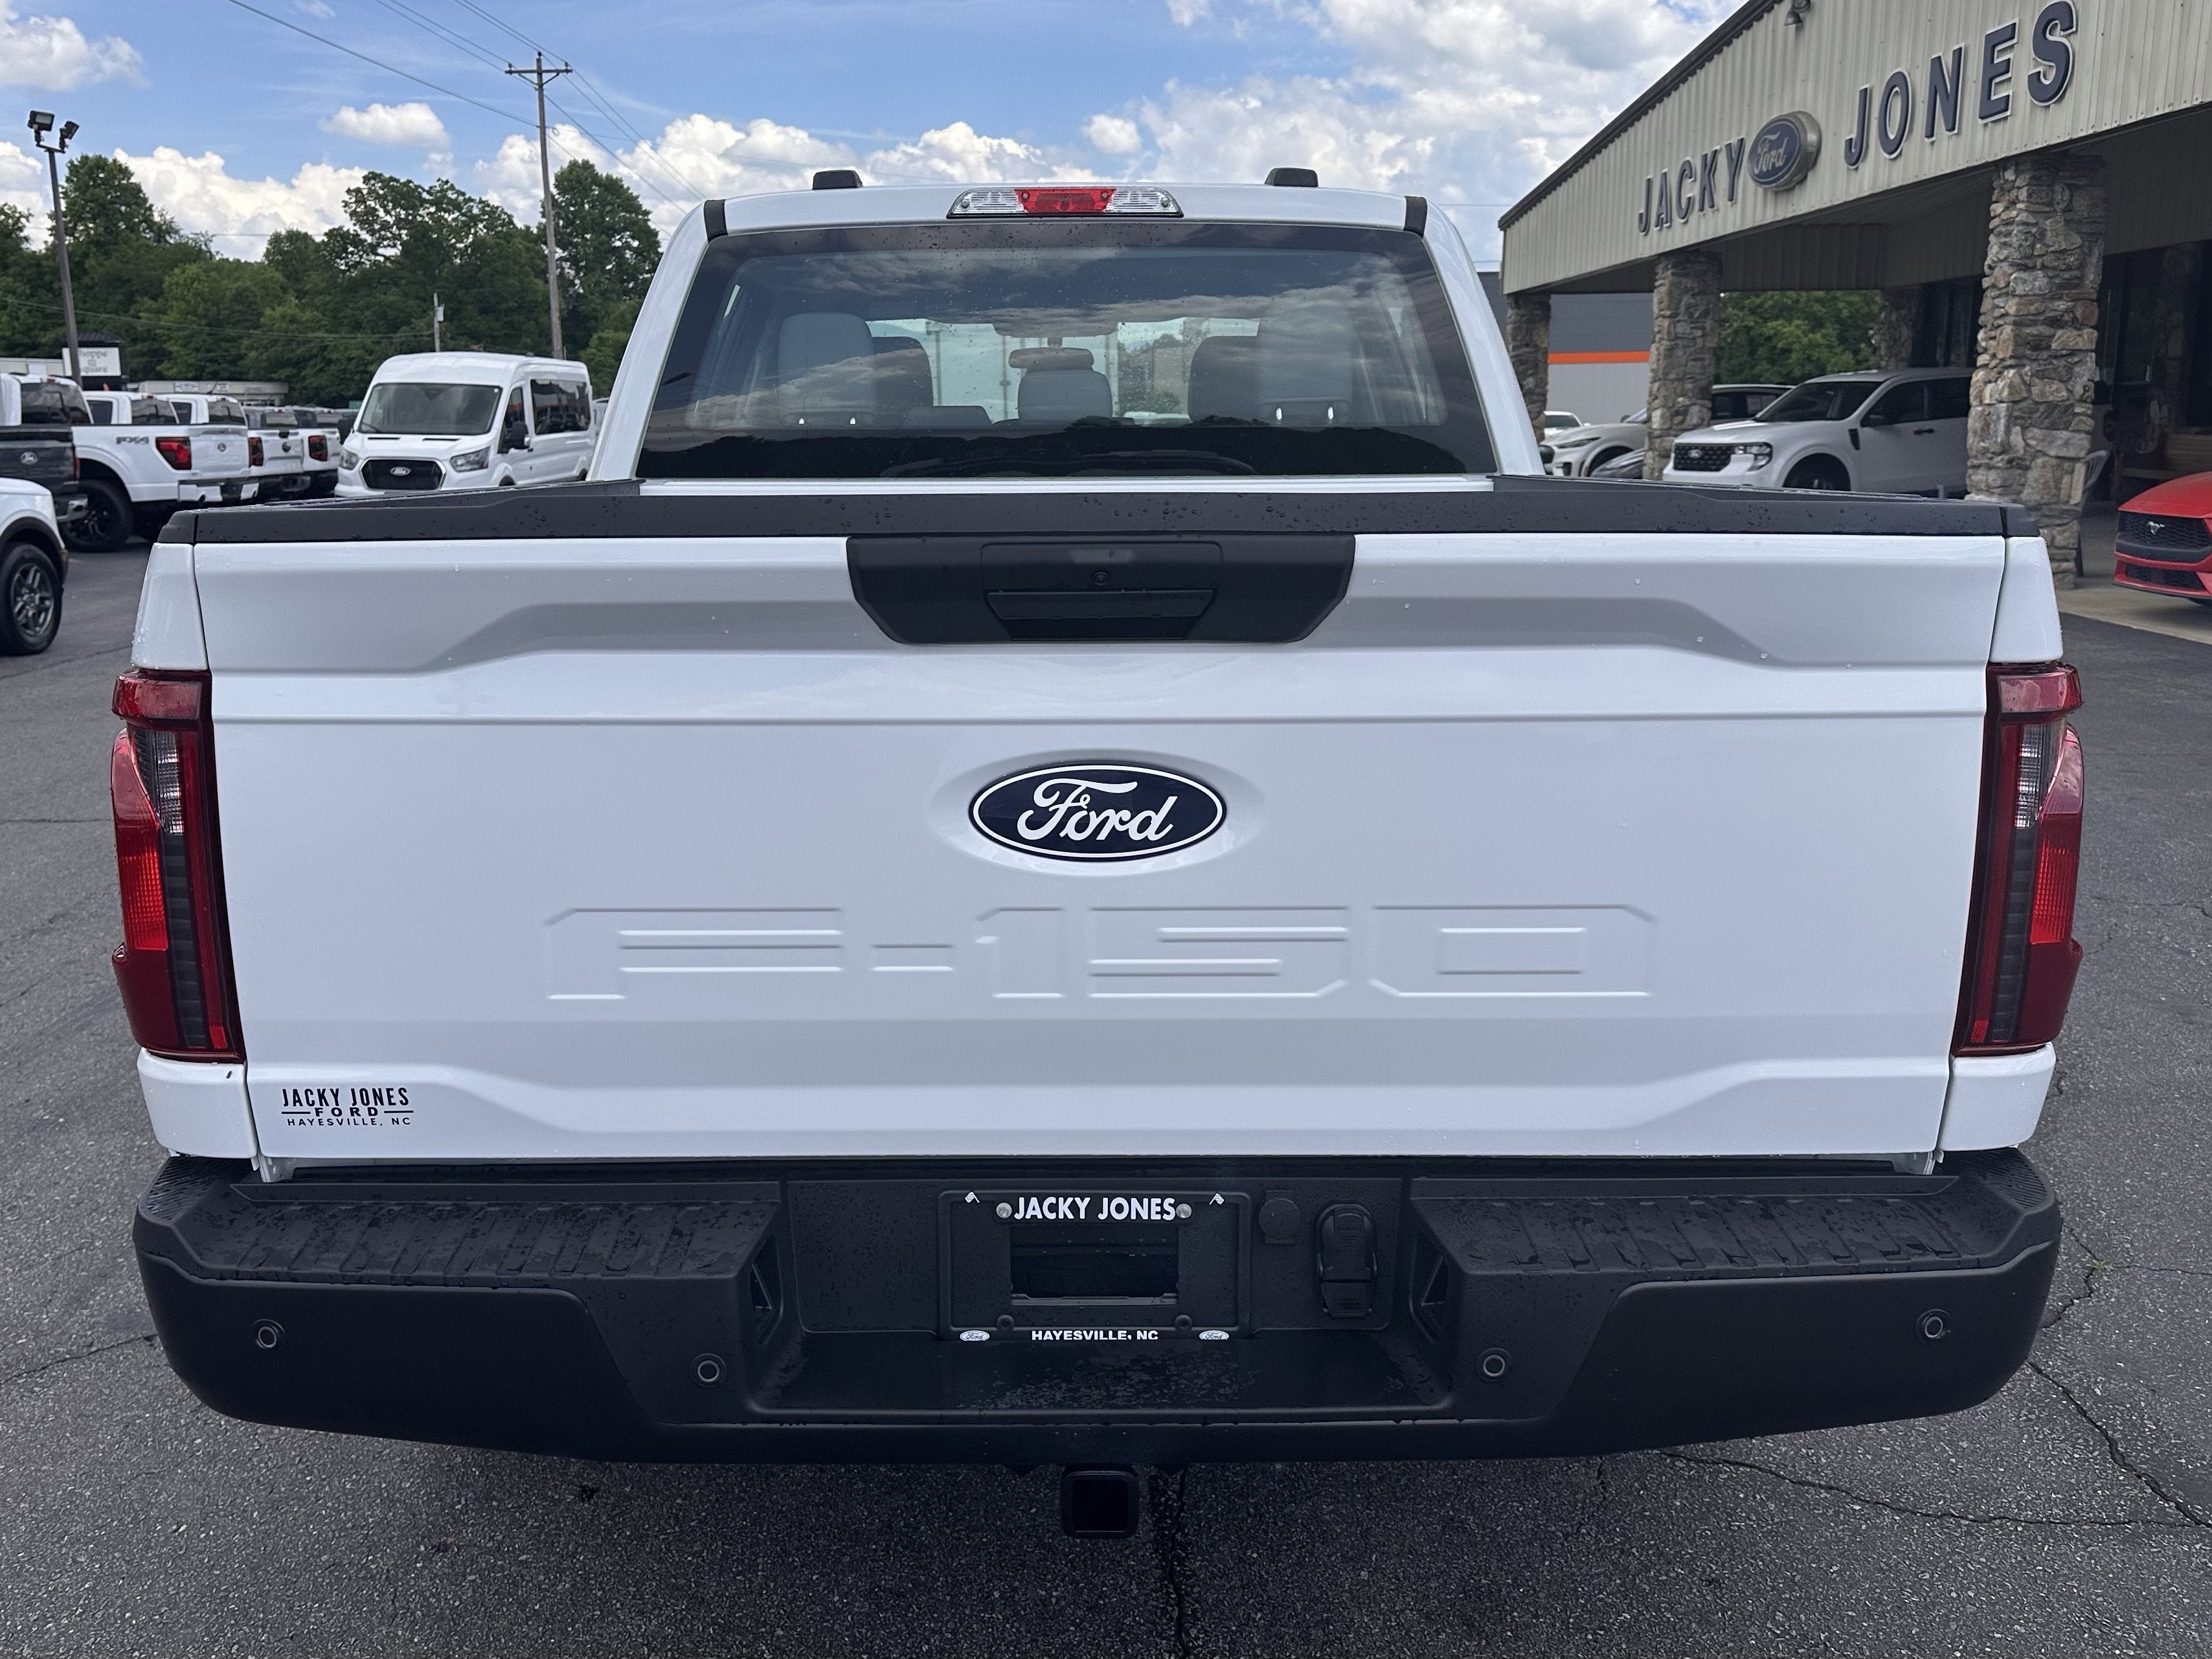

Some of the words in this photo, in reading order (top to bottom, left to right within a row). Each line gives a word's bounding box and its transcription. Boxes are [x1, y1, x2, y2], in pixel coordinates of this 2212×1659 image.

[1638, 135, 1746, 236] JACKY
[1754, 131, 1789, 174] Ford
[1844, 0, 2076, 169] JONES
[1017, 778, 1179, 841] Ford
[544, 905, 1658, 1000] F-150
[282, 1088, 339, 1107] JACKY
[350, 1087, 409, 1106] JONES
[287, 1118, 383, 1126] HAYESVILLE,
[391, 1117, 411, 1125] NC
[314, 1107, 378, 1117] FORD
[1013, 1197, 1090, 1220] JACKY
[1098, 1197, 1176, 1221] JONES
[1032, 1329, 1133, 1341] HAYESVILLE,
[1136, 1329, 1158, 1341] NC
